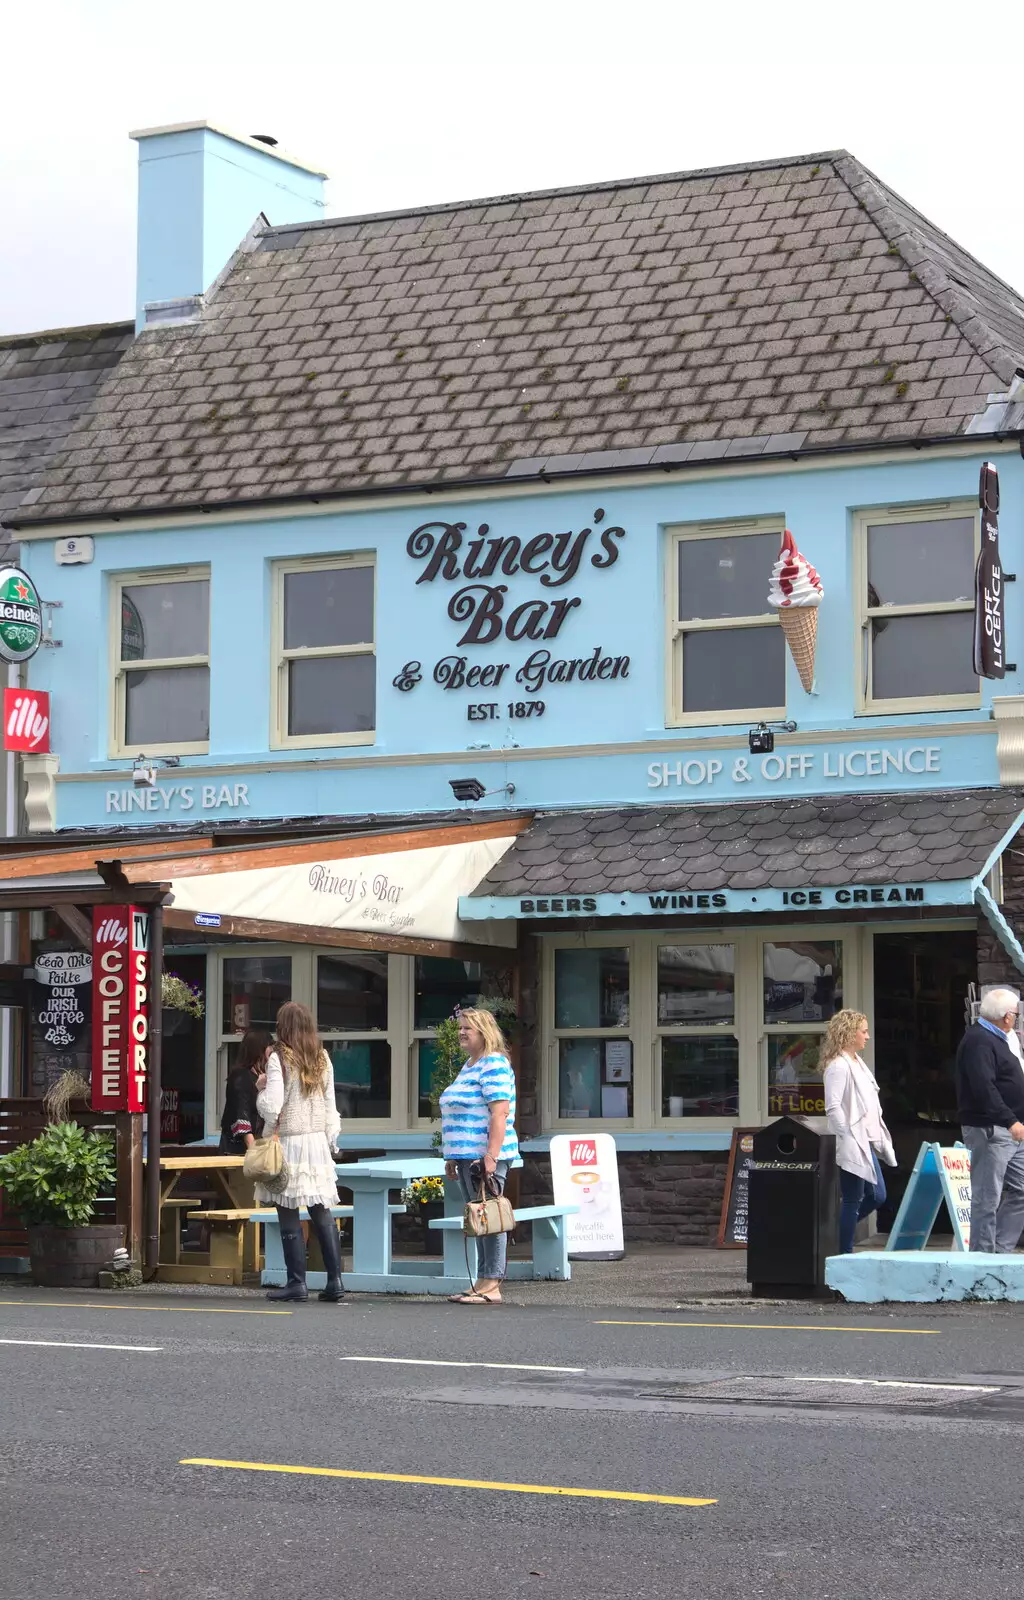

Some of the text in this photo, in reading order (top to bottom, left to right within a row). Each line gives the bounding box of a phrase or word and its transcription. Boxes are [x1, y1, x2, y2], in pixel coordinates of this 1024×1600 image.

[406, 507, 626, 588] Riney's
[447, 584, 582, 648] Bar
[984, 587, 993, 637] OFF
[992, 564, 1002, 668] LICENCE
[392, 646, 631, 693] & Beer Garden
[7, 697, 49, 747] illy
[467, 701, 545, 721] EST. 1879
[647, 747, 941, 789] SHOP & OFF LICENCE
[106, 783, 250, 813] RINEY'S BAR
[309, 864, 404, 905] Riney's Bar
[520, 888, 924, 913] BEERS WINES ICE CREAM
[96, 919, 128, 949] illy
[133, 915, 149, 949] TV
[47, 998, 79, 1012] IRISH
[52, 987, 75, 998] OUR
[99, 950, 124, 1097] COFFEE
[132, 954, 148, 1103] SPORT
[788, 1095, 826, 1112] Lice
[572, 1143, 596, 1164] illy
[956, 1206, 971, 1223] CRE
